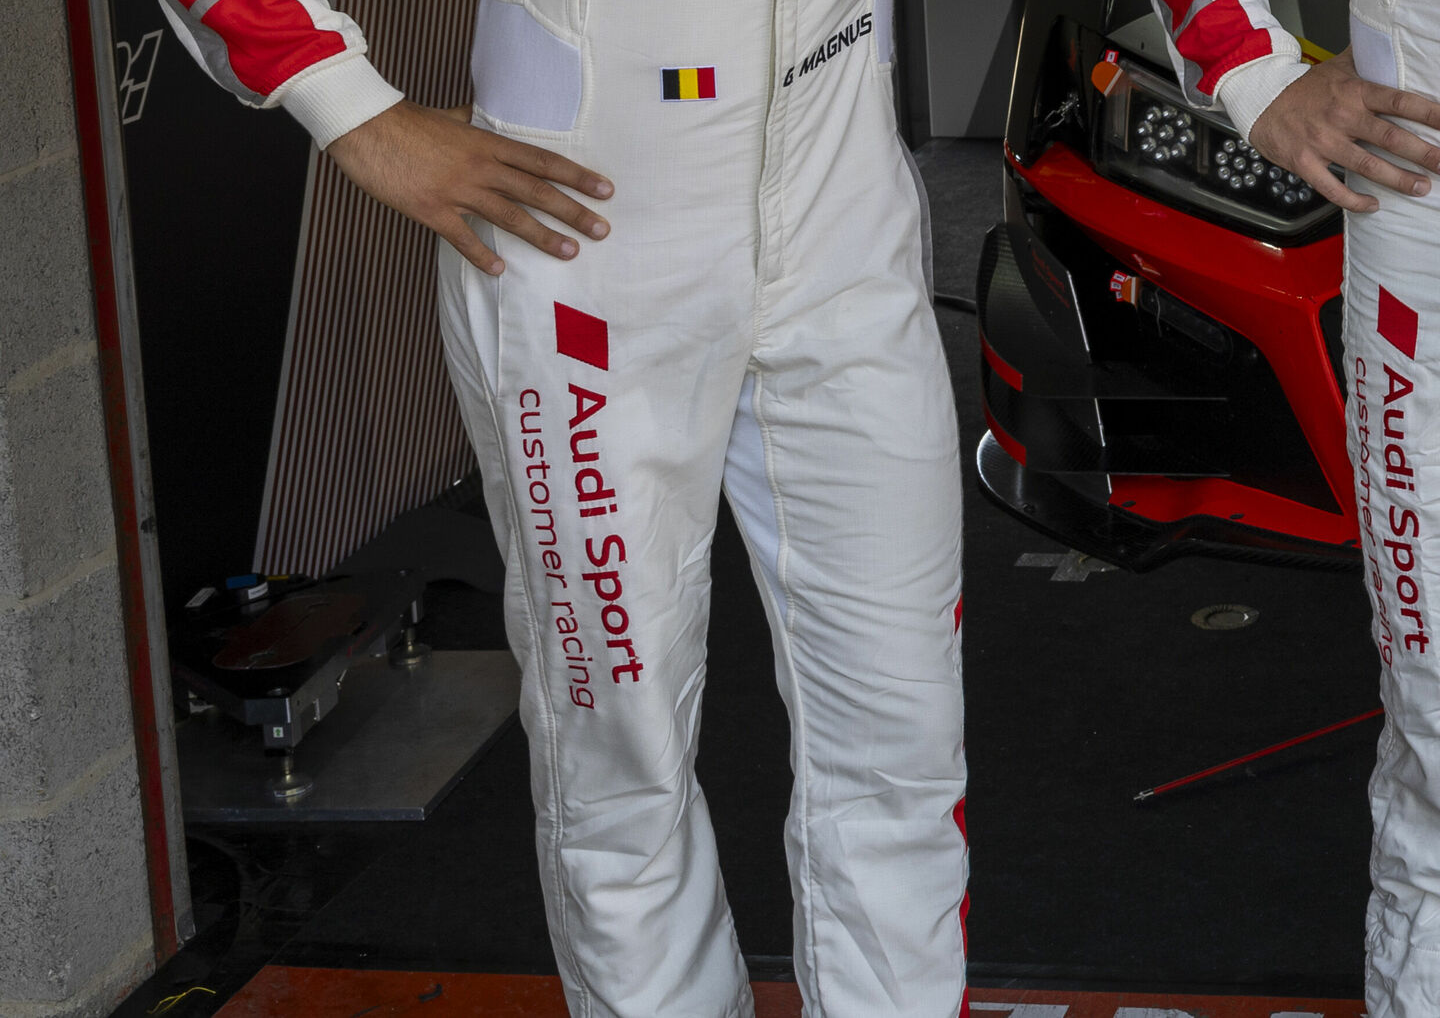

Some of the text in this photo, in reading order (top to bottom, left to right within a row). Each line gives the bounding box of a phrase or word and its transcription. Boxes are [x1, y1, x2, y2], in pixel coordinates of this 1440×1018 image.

[799, 12, 873, 78] MAGNUS
[520, 388, 595, 711] customer racing
[567, 382, 644, 685] Audi Sport
[1355, 356, 1376, 548] customer
[1382, 362, 1429, 655] Audi Sport
